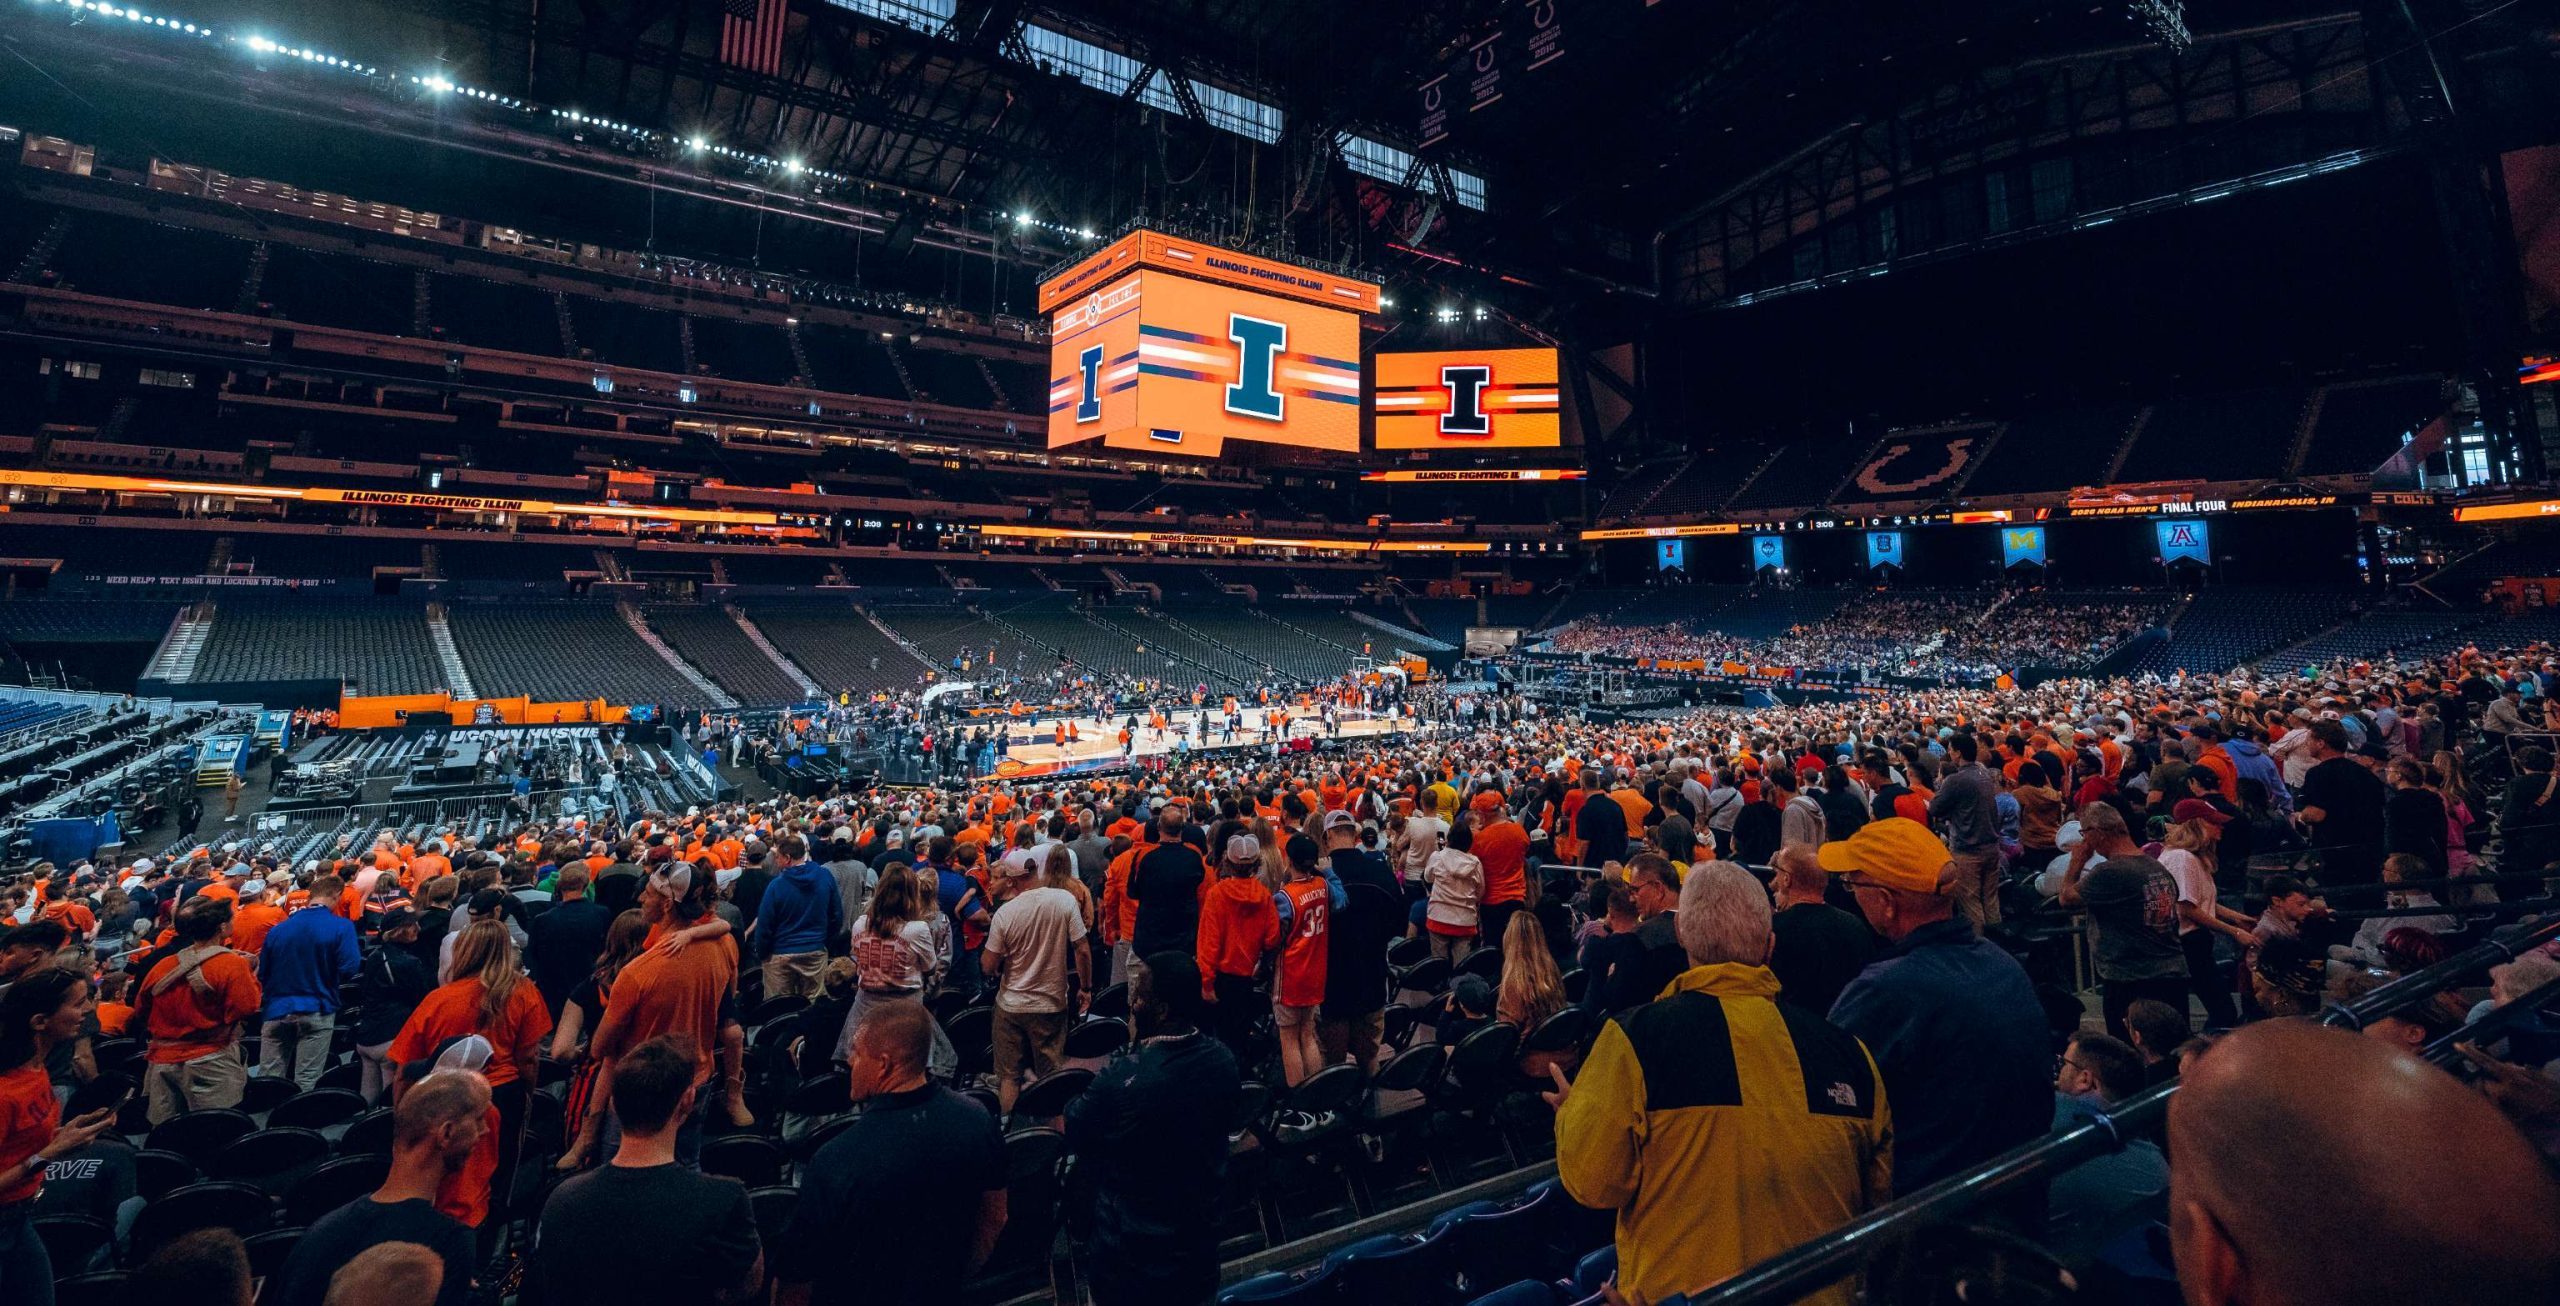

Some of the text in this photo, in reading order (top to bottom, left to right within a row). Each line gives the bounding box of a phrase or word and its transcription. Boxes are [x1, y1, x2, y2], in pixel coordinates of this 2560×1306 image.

[1205, 256, 1324, 292] ILLINOIS FIGHTING ILLINI
[1225, 312, 1287, 421] I
[1077, 343, 1104, 423] I
[1440, 366, 1490, 433] I
[1415, 471, 1457, 480] ILLINOIS
[1457, 471, 1509, 480] FIGHTING
[341, 491, 523, 511] ILLINOIS FIGHTING ILLINI
[2071, 496, 2337, 516] 2026 NCAA MEN'S FINAL FOUR INDIANAPOLIS, IN
[2393, 495, 2435, 505] COLTS
[1150, 533, 1182, 542] ILLINOIS
[1182, 535, 1218, 543] FIGHTING
[2010, 530, 2037, 550] M
[2167, 524, 2199, 547] A
[106, 576, 129, 584] NEED
[130, 576, 156, 585] HELP?
[160, 577, 181, 585] TEXT
[182, 577, 204, 585] ISSUE
[205, 577, 222, 586] AND
[223, 578, 260, 586] LOCATION
[261, 578, 271, 586] TO
[1303, 904, 1325, 938] 32
